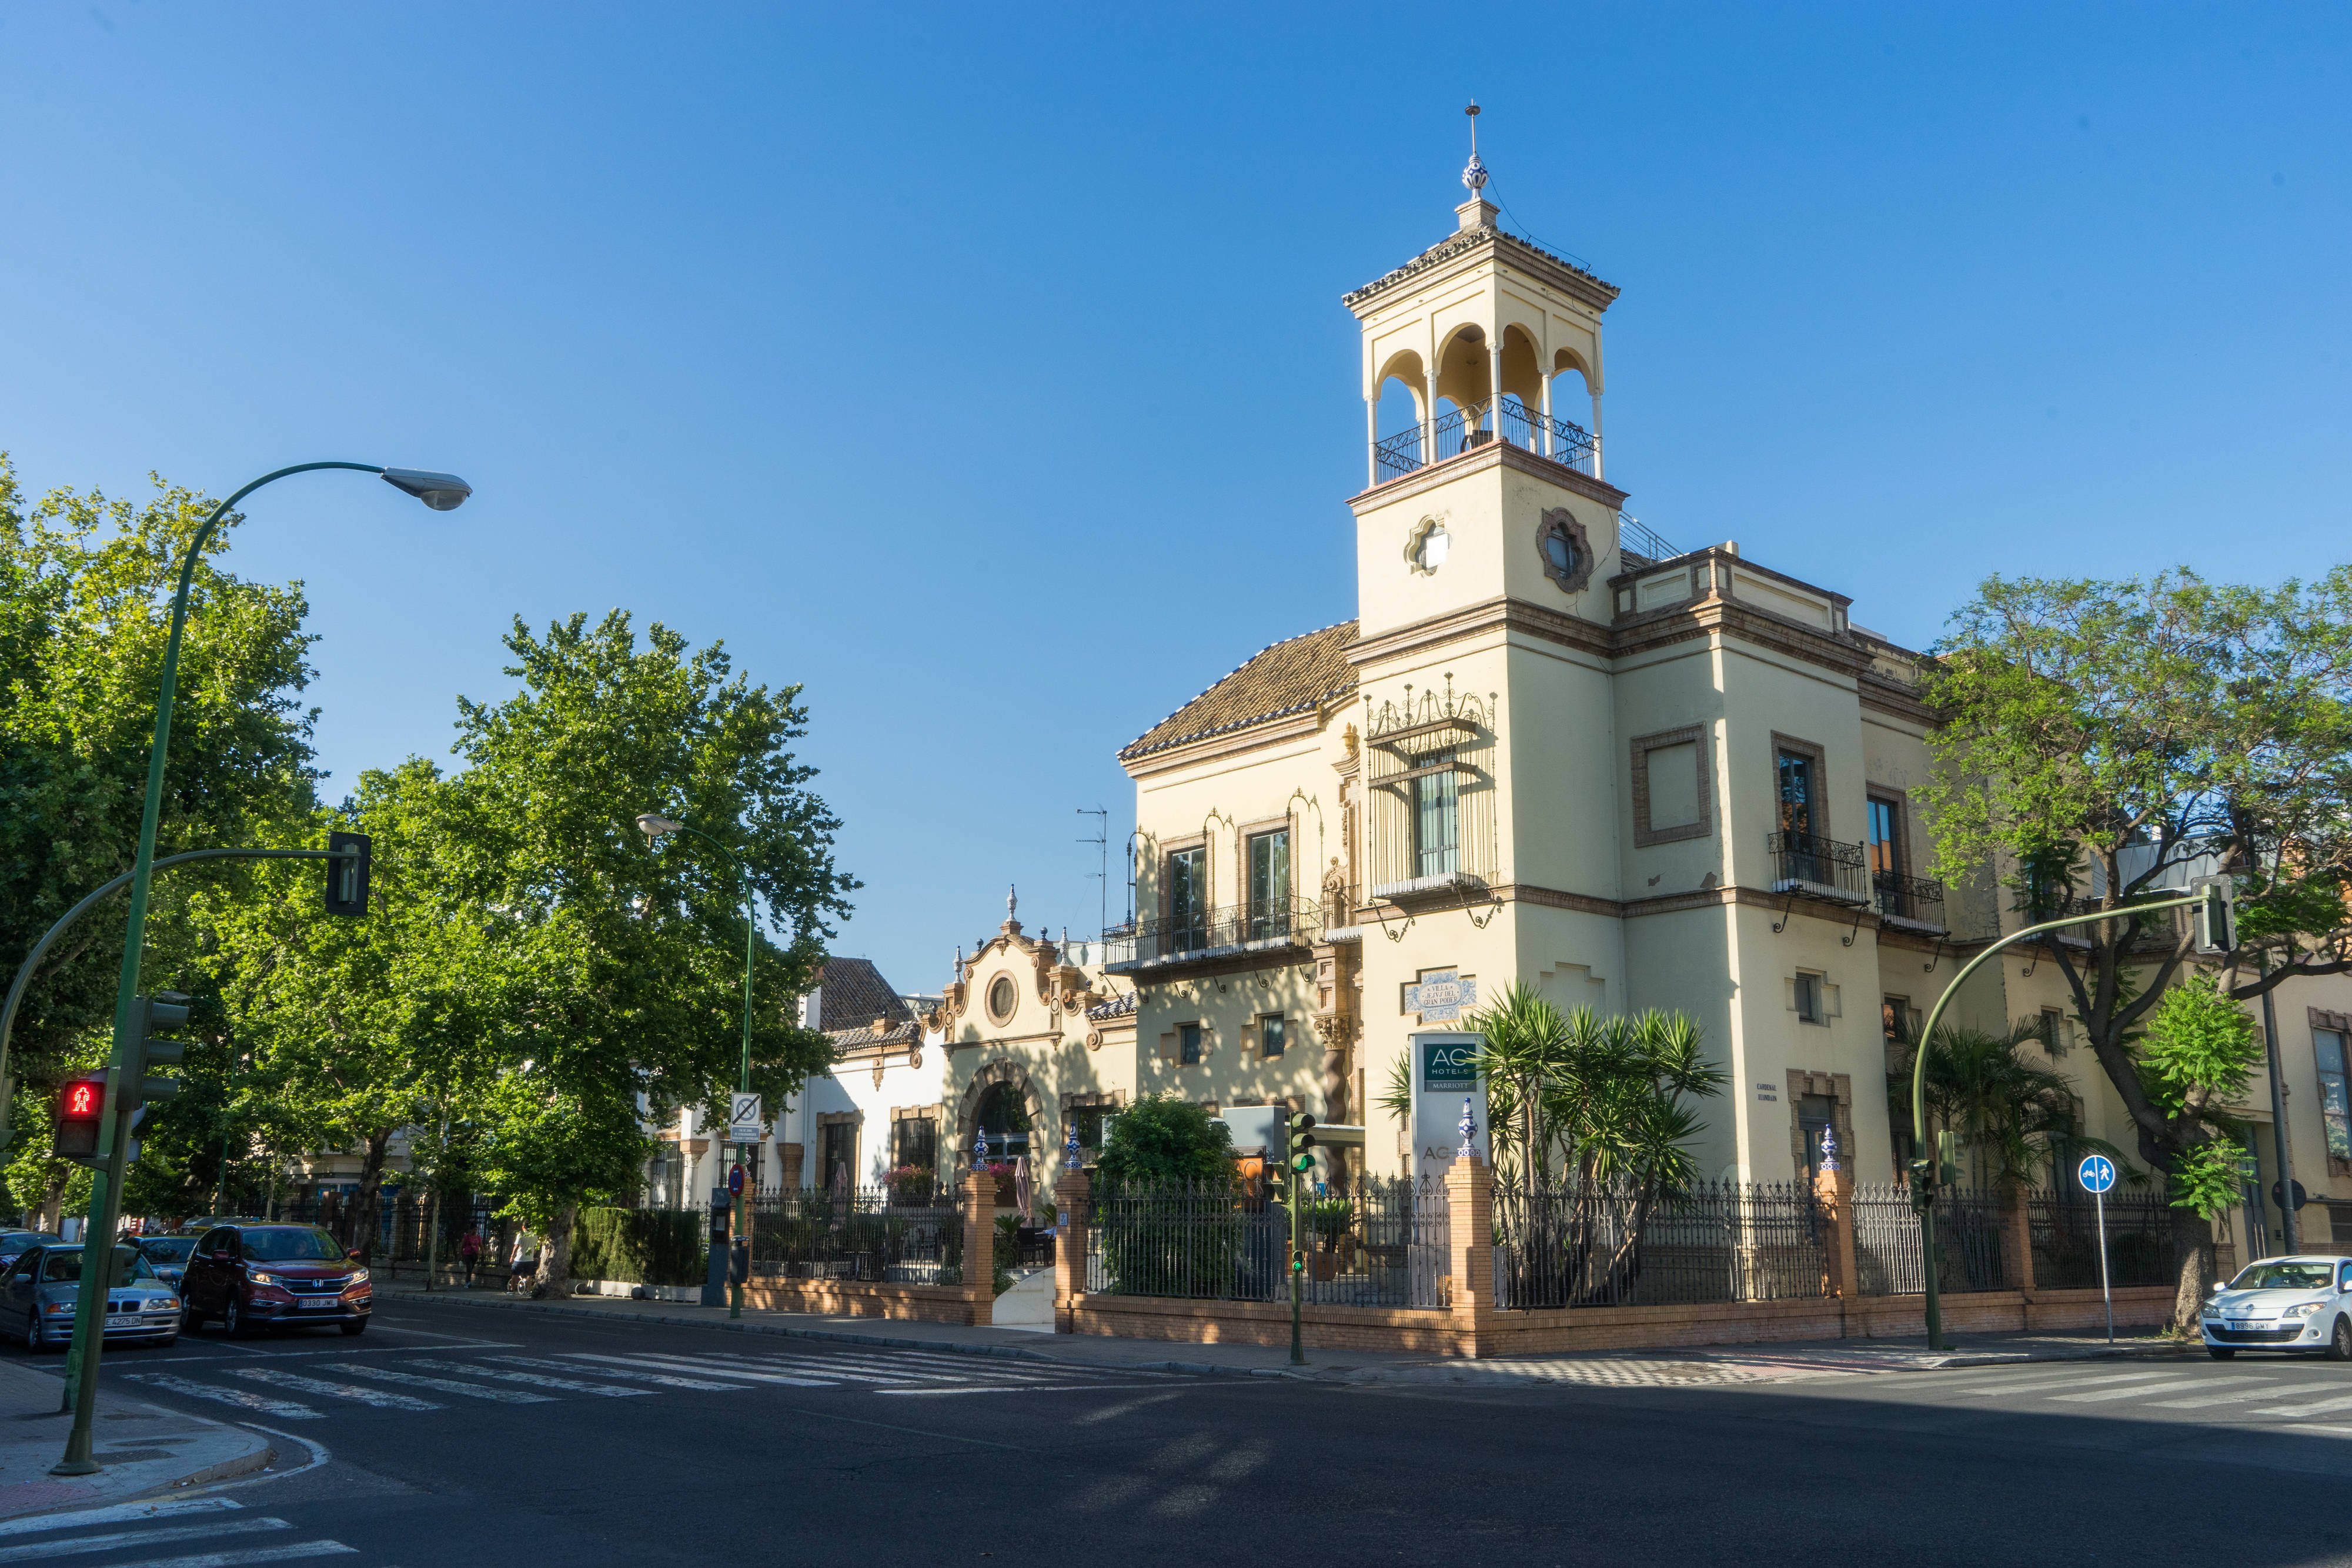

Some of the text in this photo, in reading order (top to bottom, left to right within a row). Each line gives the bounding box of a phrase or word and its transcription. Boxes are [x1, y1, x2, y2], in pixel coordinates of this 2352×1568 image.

[1432, 1048, 1467, 1066] AC
[1757, 1083, 1776, 1091] CARDENAL
[1423, 1146, 1449, 1159] AC
